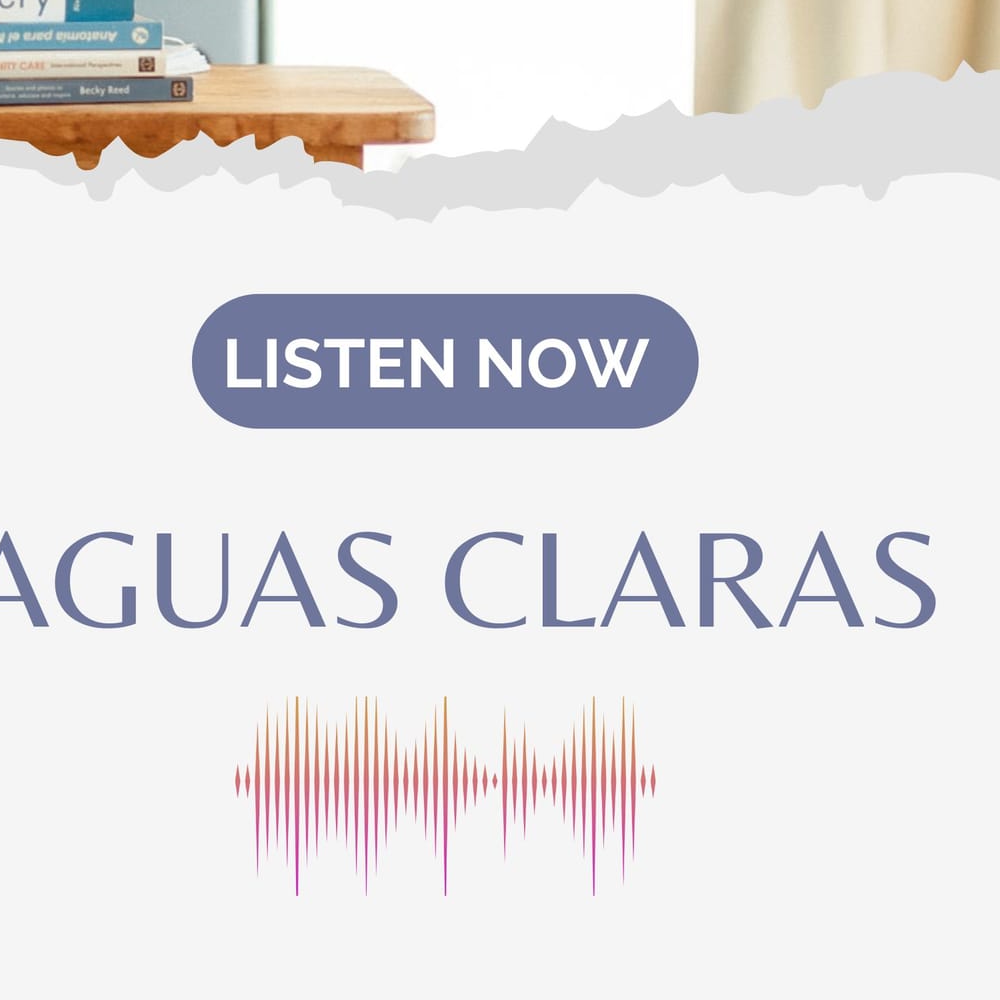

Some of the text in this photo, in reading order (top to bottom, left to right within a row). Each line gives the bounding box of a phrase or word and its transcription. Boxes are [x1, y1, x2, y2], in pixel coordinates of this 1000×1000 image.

[8, 32, 21, 43] el
[23, 29, 53, 41] para
[20, 62, 45, 70] CARE
[80, 84, 130, 96] Becky Reed
